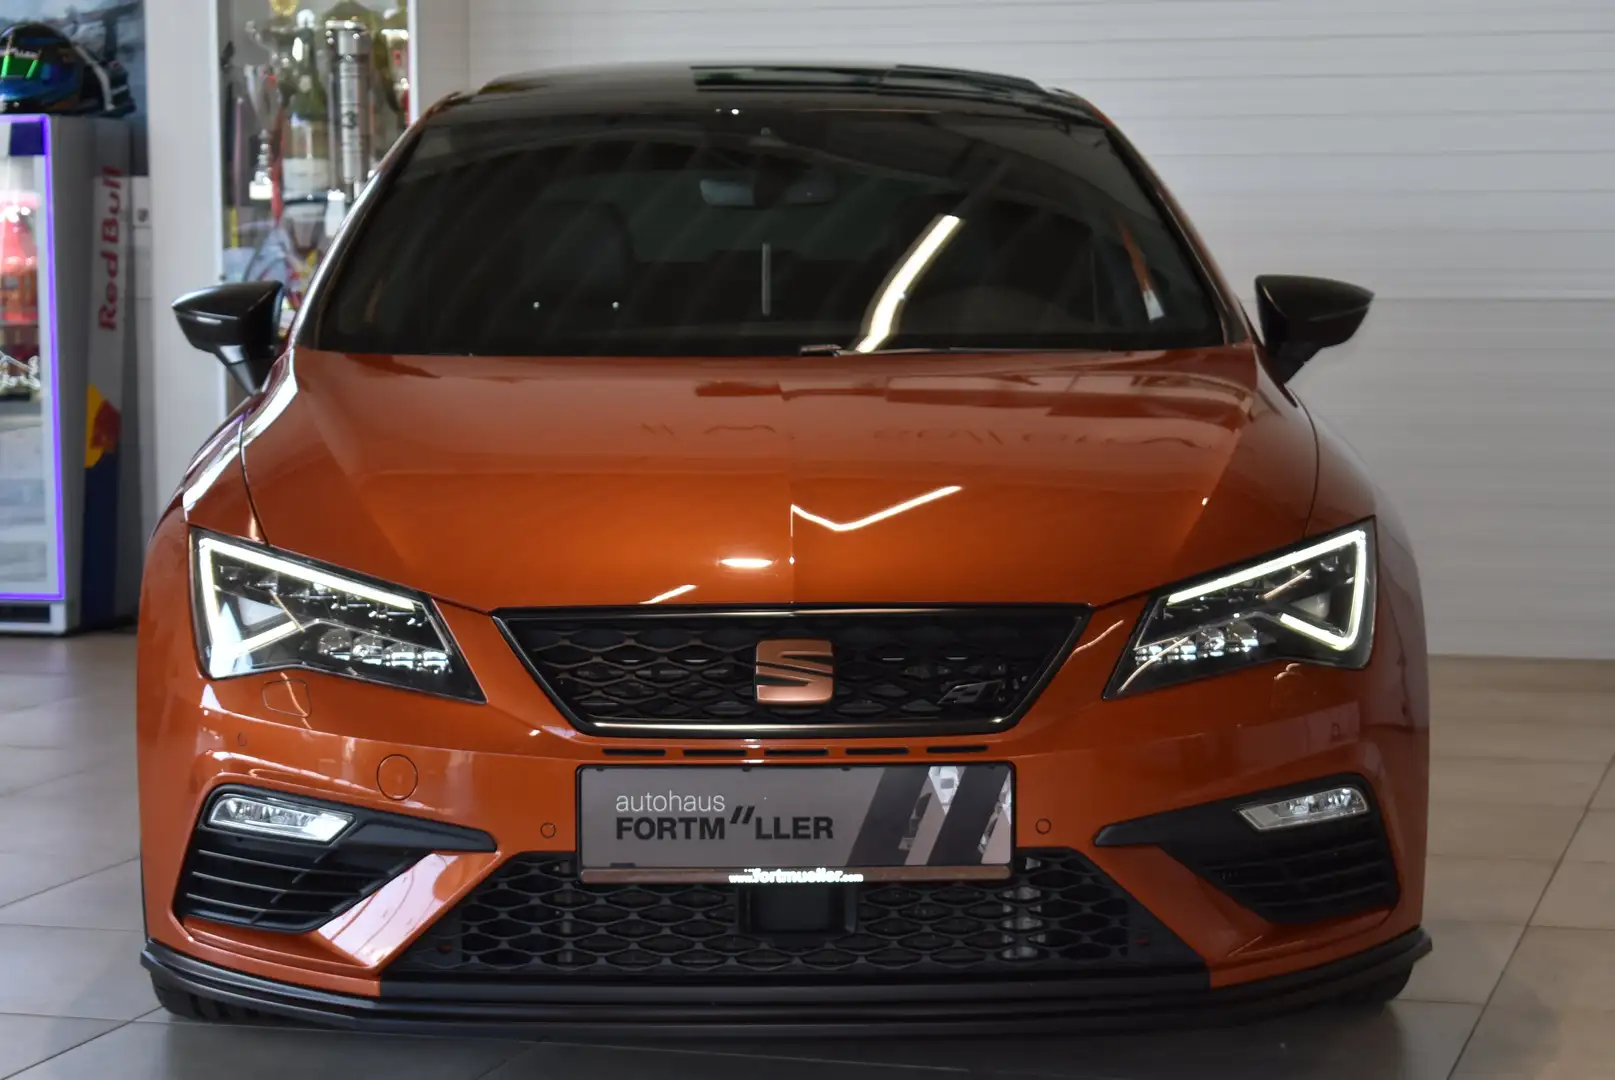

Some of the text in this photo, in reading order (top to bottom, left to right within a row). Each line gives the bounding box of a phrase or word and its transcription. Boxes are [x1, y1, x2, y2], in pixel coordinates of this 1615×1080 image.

[98, 165, 123, 331] Red Bull
[616, 790, 725, 812] autohaus
